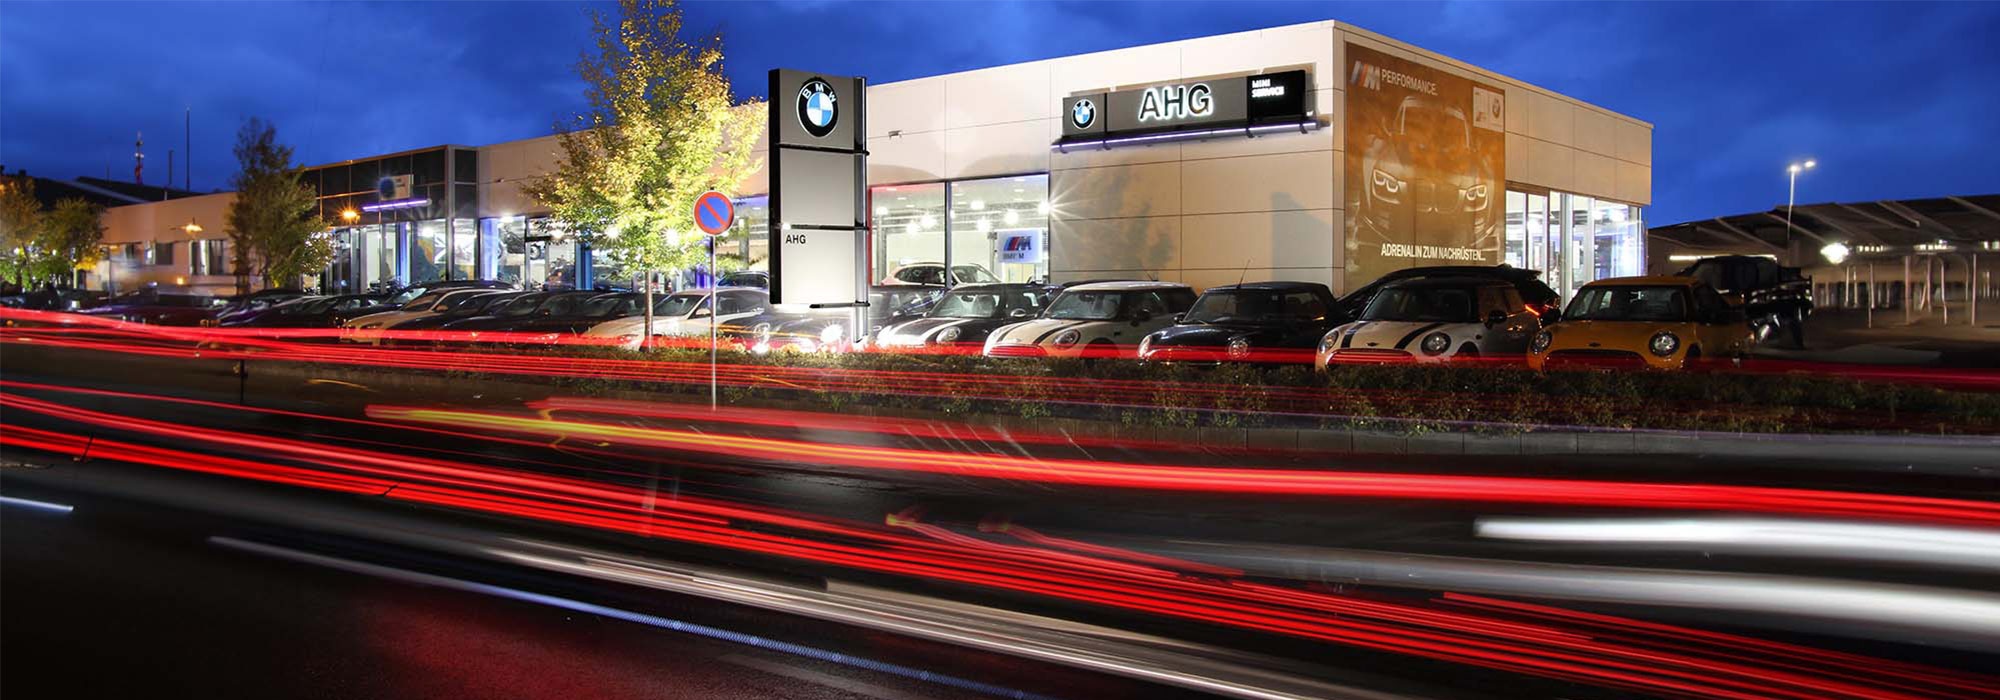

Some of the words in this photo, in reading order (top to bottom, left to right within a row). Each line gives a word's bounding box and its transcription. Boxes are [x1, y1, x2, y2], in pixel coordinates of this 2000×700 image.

[1251, 78, 1271, 88] MINI
[802, 83, 837, 103] BMW
[1139, 84, 1213, 121] AHG
[785, 234, 806, 244] AHG
[1381, 243, 1422, 258] ADRENALIN
[1422, 245, 1438, 259] ZUM
